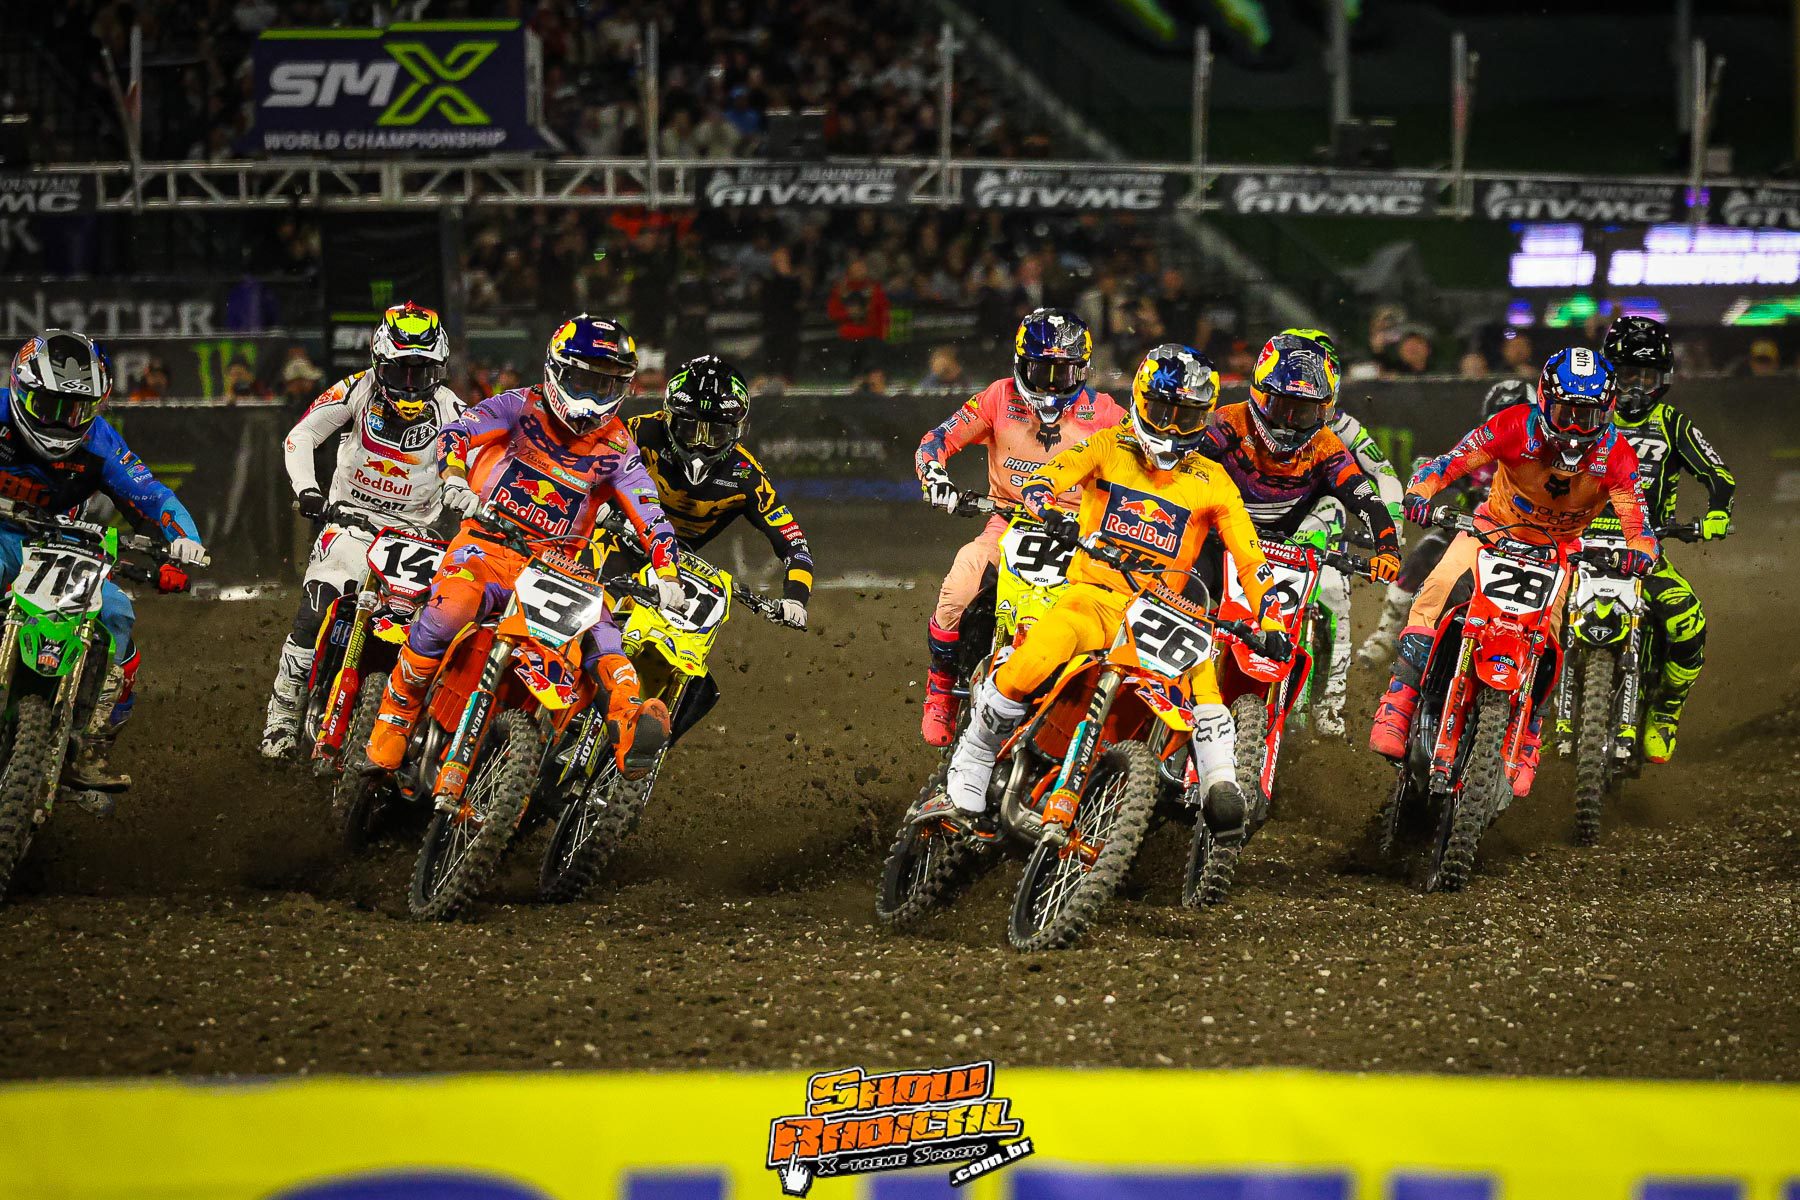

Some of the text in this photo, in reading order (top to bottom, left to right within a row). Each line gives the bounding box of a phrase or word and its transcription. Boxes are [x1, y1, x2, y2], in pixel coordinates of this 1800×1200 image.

[262, 41, 498, 126] SMX
[264, 129, 507, 150] WORLD CHAMPIONSHIP
[350, 488, 407, 512] DUCATI
[354, 468, 413, 497] Red Bull
[495, 487, 570, 537] Red Bull
[1105, 513, 1178, 553] Red Bull
[383, 541, 440, 585] 14
[1013, 535, 1074, 577] 94
[392, 585, 415, 595] DUCATI
[1483, 562, 1556, 609] 28
[523, 578, 593, 637] 3
[1131, 608, 1209, 672] 26
